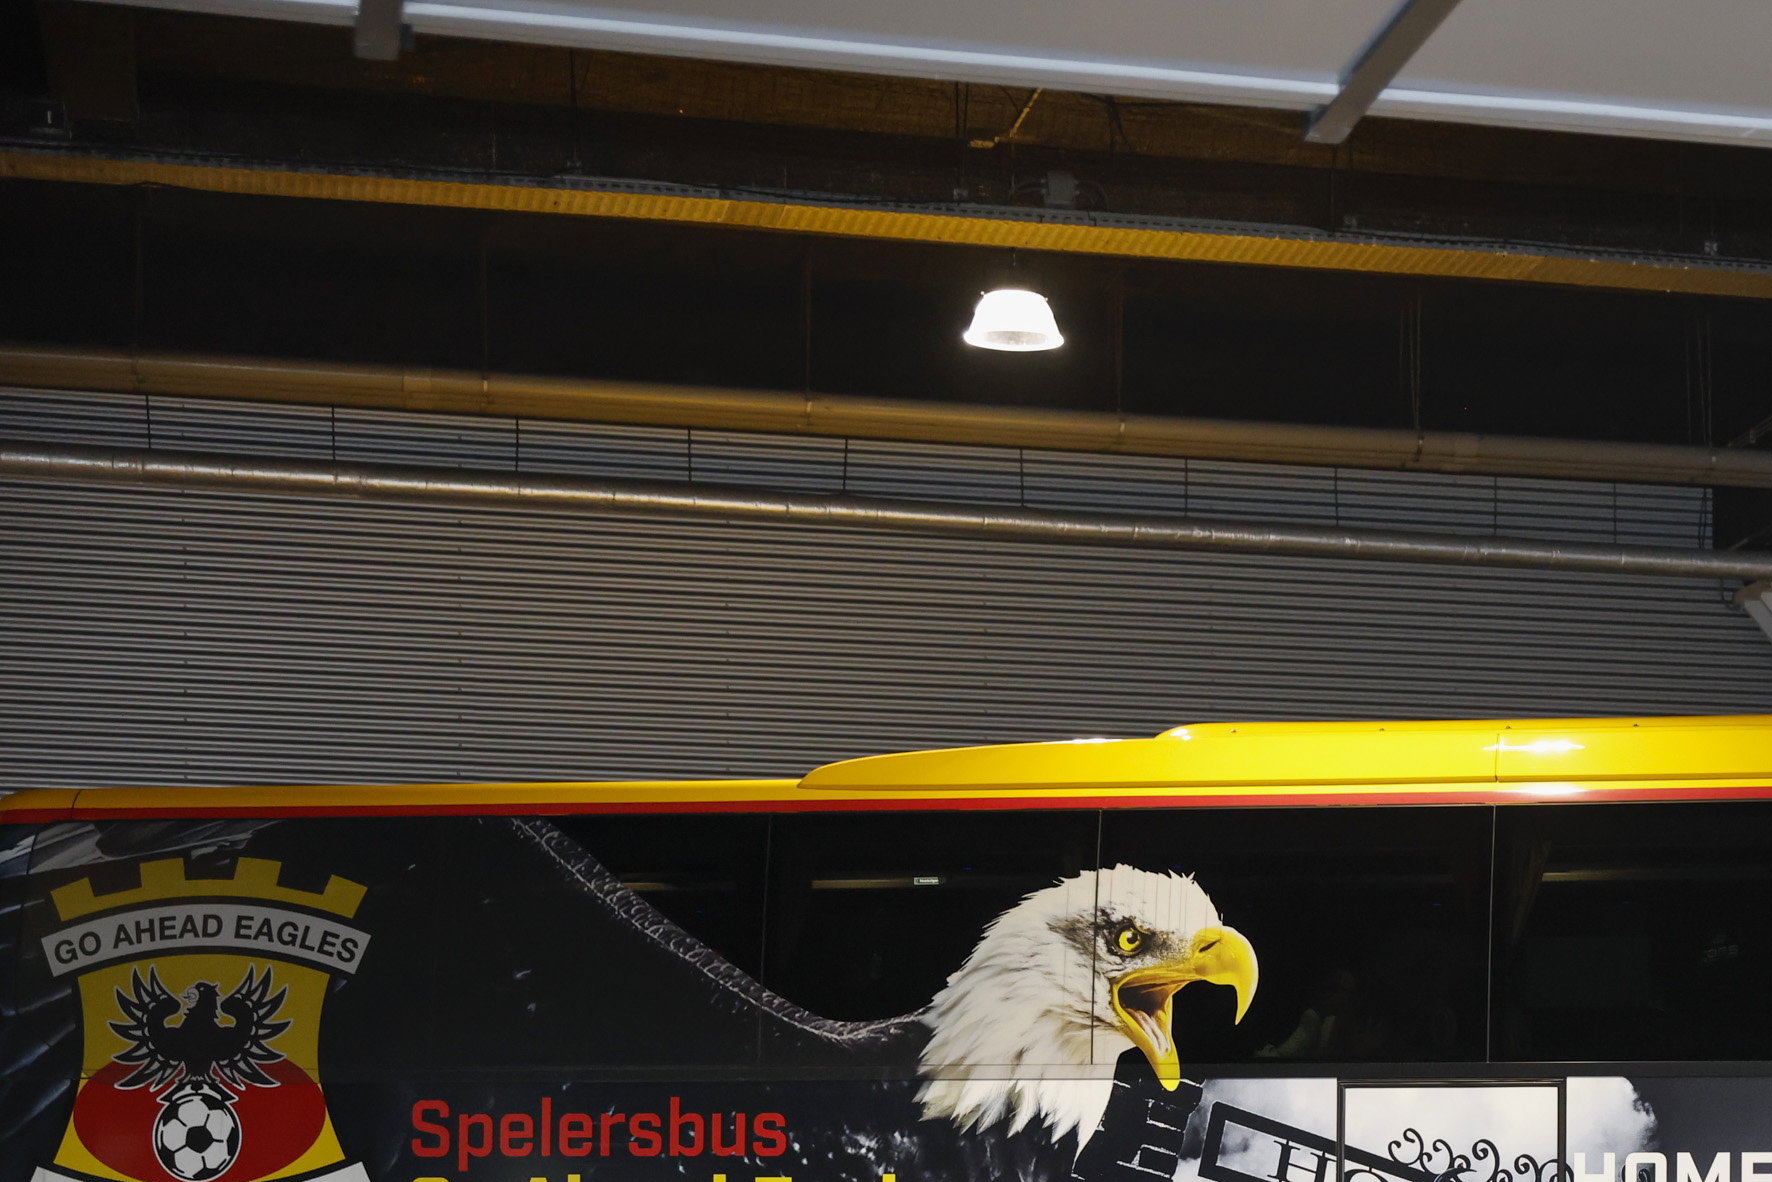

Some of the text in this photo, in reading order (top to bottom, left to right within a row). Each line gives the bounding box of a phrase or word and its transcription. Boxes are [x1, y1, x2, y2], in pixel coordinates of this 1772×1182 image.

[54, 914, 360, 965] GO AHEAD EAGLES
[410, 1096, 788, 1172] Spelersbus
